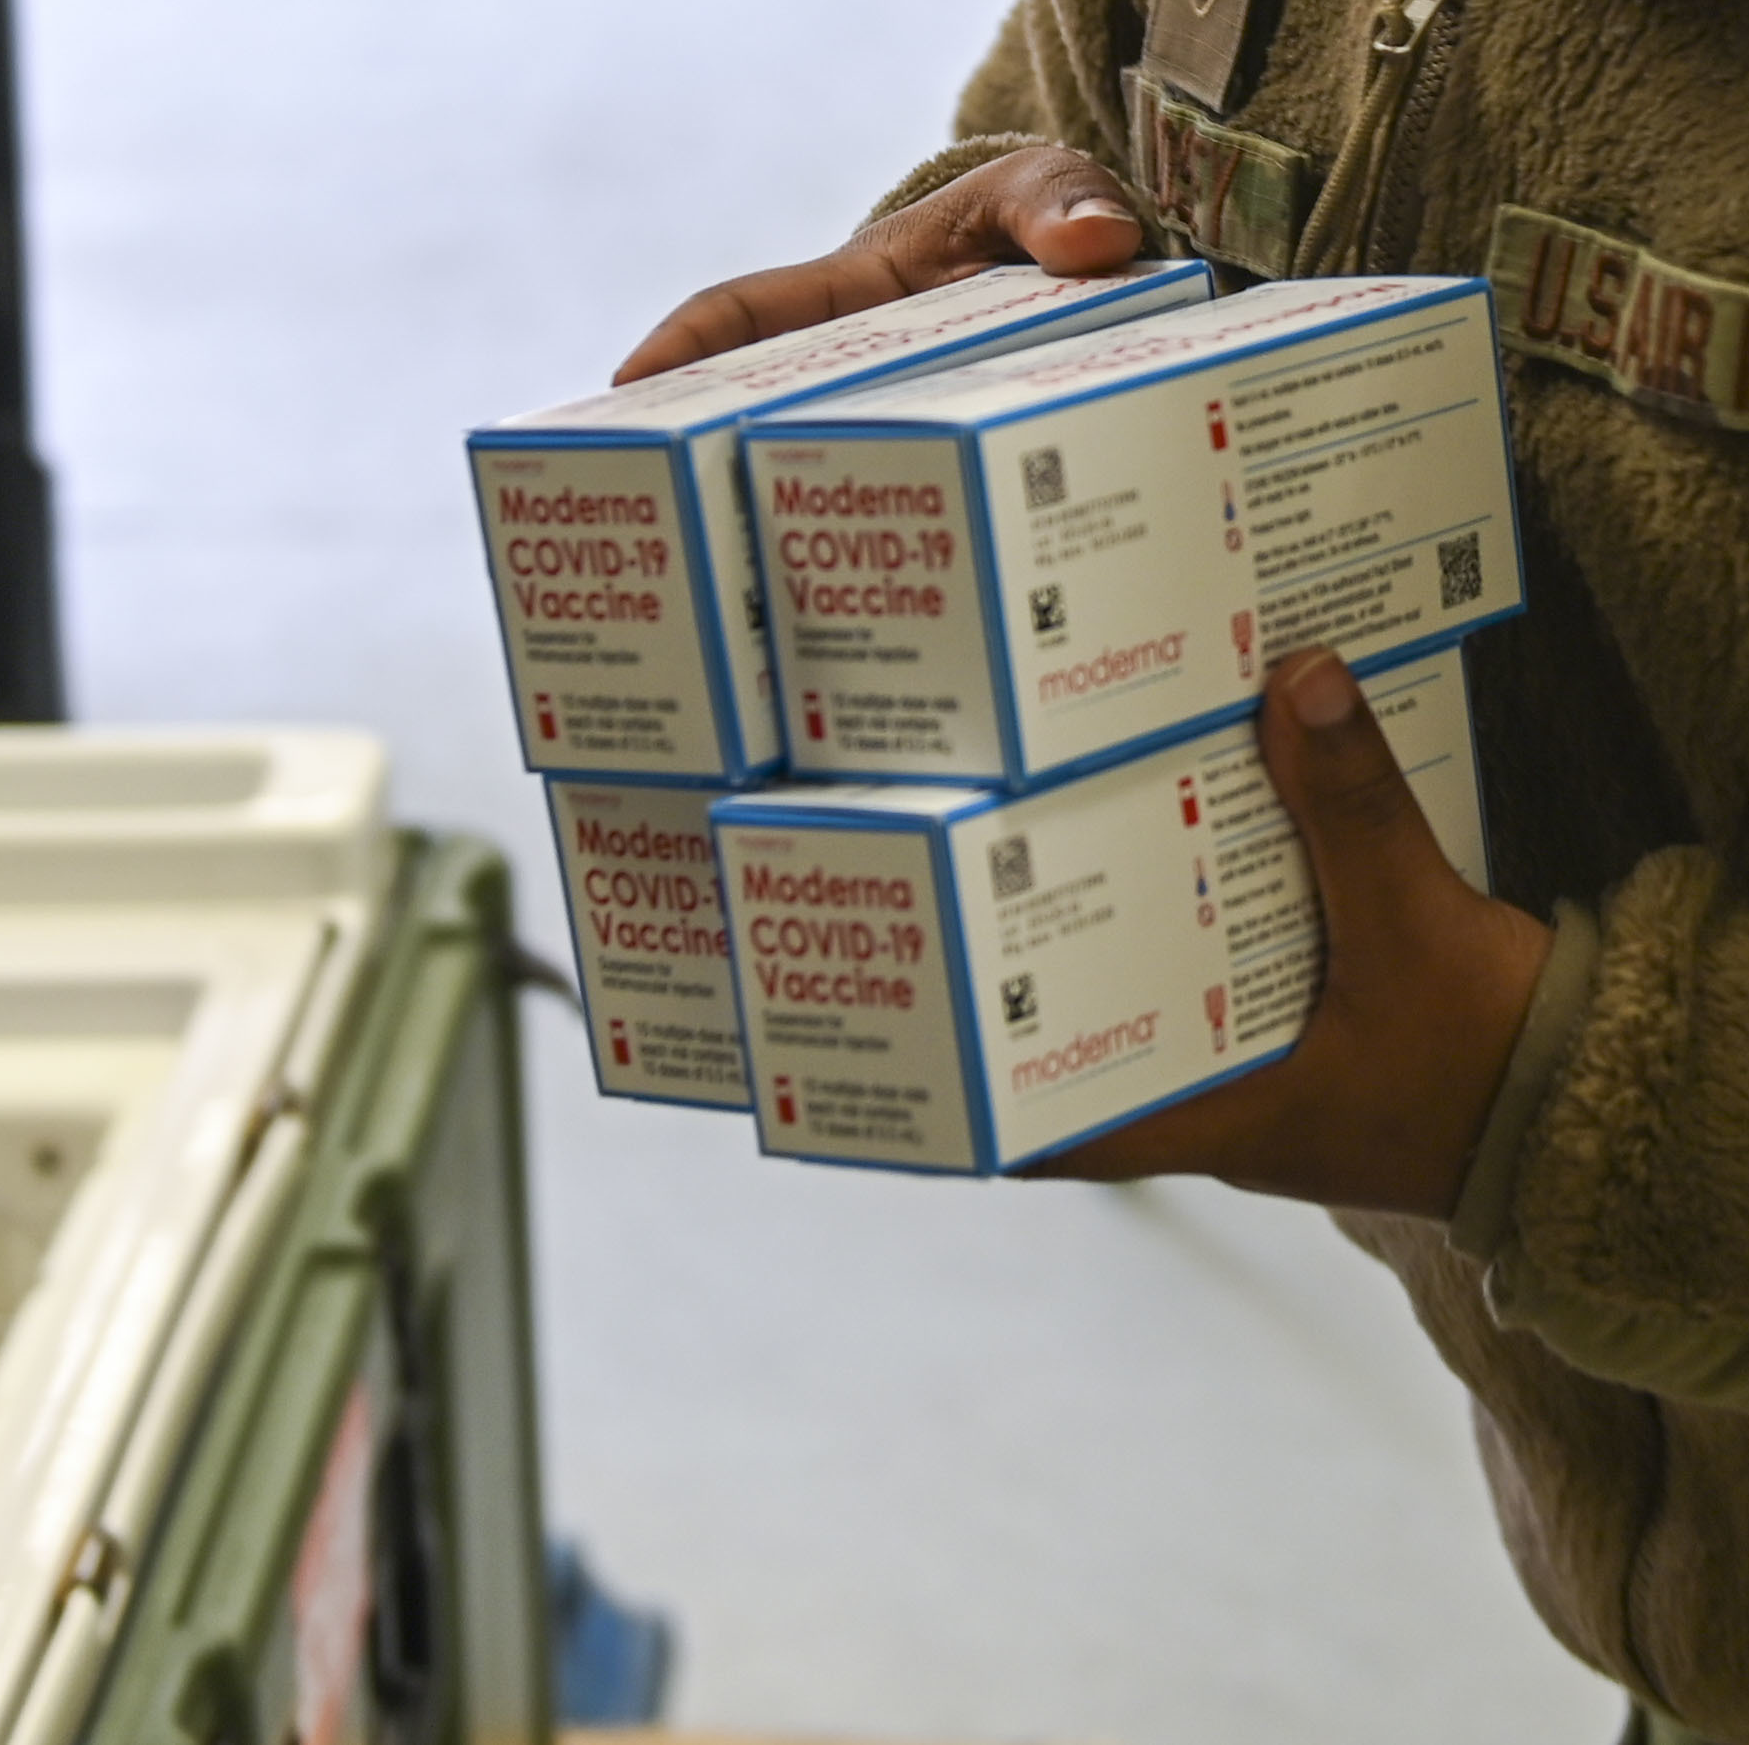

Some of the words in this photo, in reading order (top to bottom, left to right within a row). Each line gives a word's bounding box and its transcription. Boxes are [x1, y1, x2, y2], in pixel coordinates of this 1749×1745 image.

[1617, 272, 1714, 402] AIR
[499, 485, 658, 525] Moderna
[773, 474, 945, 517] Moderna
[508, 537, 669, 577] COVID-19
[779, 530, 956, 570] COVID-19
[513, 581, 661, 622] Vaccine
[784, 574, 946, 618] Vaccine
[1039, 630, 1188, 704] moderna
[576, 817, 712, 863] Modern
[584, 867, 726, 914] COVID-1
[743, 864, 915, 911] Moderna
[590, 910, 730, 959] Vaccine
[750, 915, 926, 964] COVID-19
[755, 961, 915, 1009] Vaccine
[1012, 1010, 1160, 1094] moderna
